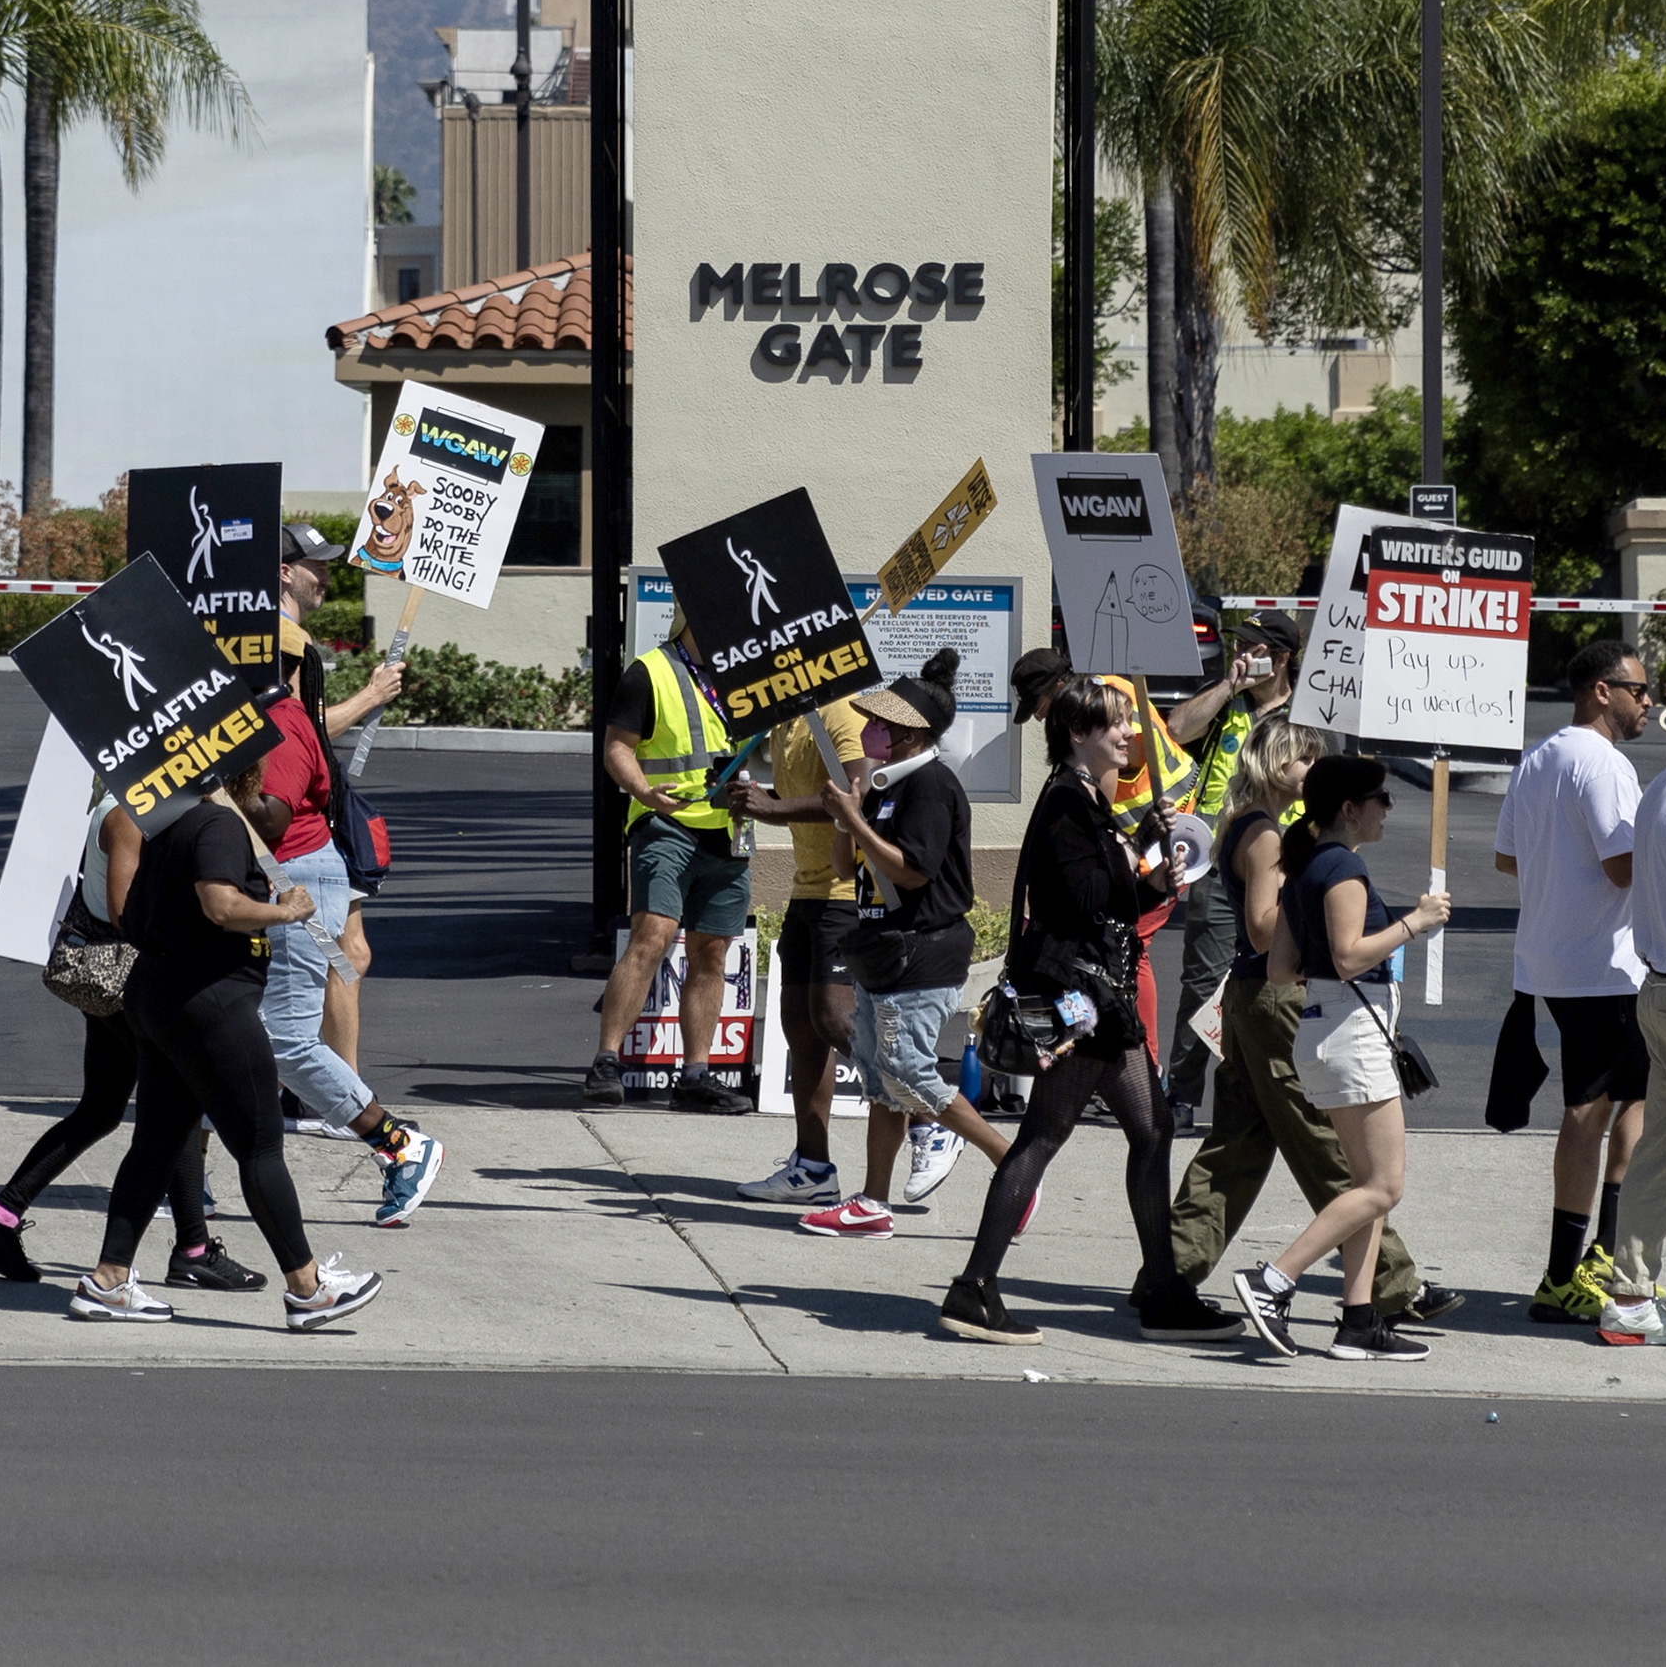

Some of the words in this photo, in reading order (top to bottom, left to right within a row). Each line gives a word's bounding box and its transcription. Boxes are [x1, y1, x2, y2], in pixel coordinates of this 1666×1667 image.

[697, 262, 986, 306] MELROSE
[758, 323, 924, 368] GATE
[420, 422, 508, 468] WGAW
[432, 476, 498, 515] SCOOBY
[967, 469, 992, 517] IATSE
[1062, 495, 1143, 518] WGAW
[1417, 493, 1449, 503] GUEST
[422, 516, 445, 533] DO
[446, 524, 482, 546] THE
[429, 497, 487, 533] DOOBY
[419, 532, 476, 568] WRITE
[1381, 539, 1465, 567] WRITERS
[1468, 547, 1523, 572] GUILD
[411, 555, 476, 593] THING!
[1134, 574, 1158, 587] PUT
[1441, 569, 1461, 584] ON
[951, 589, 993, 602] GATE
[1140, 591, 1156, 602] ME
[1377, 581, 1520, 634] STRIKE!
[773, 648, 803, 670] ON
[1387, 635, 1430, 690] Pay
[727, 639, 870, 720] STRIKE!
[1387, 694, 1413, 725] ya
[1423, 689, 1515, 724] weirdos!
[163, 724, 195, 754] ON
[125, 700, 265, 816] STRIKE!
